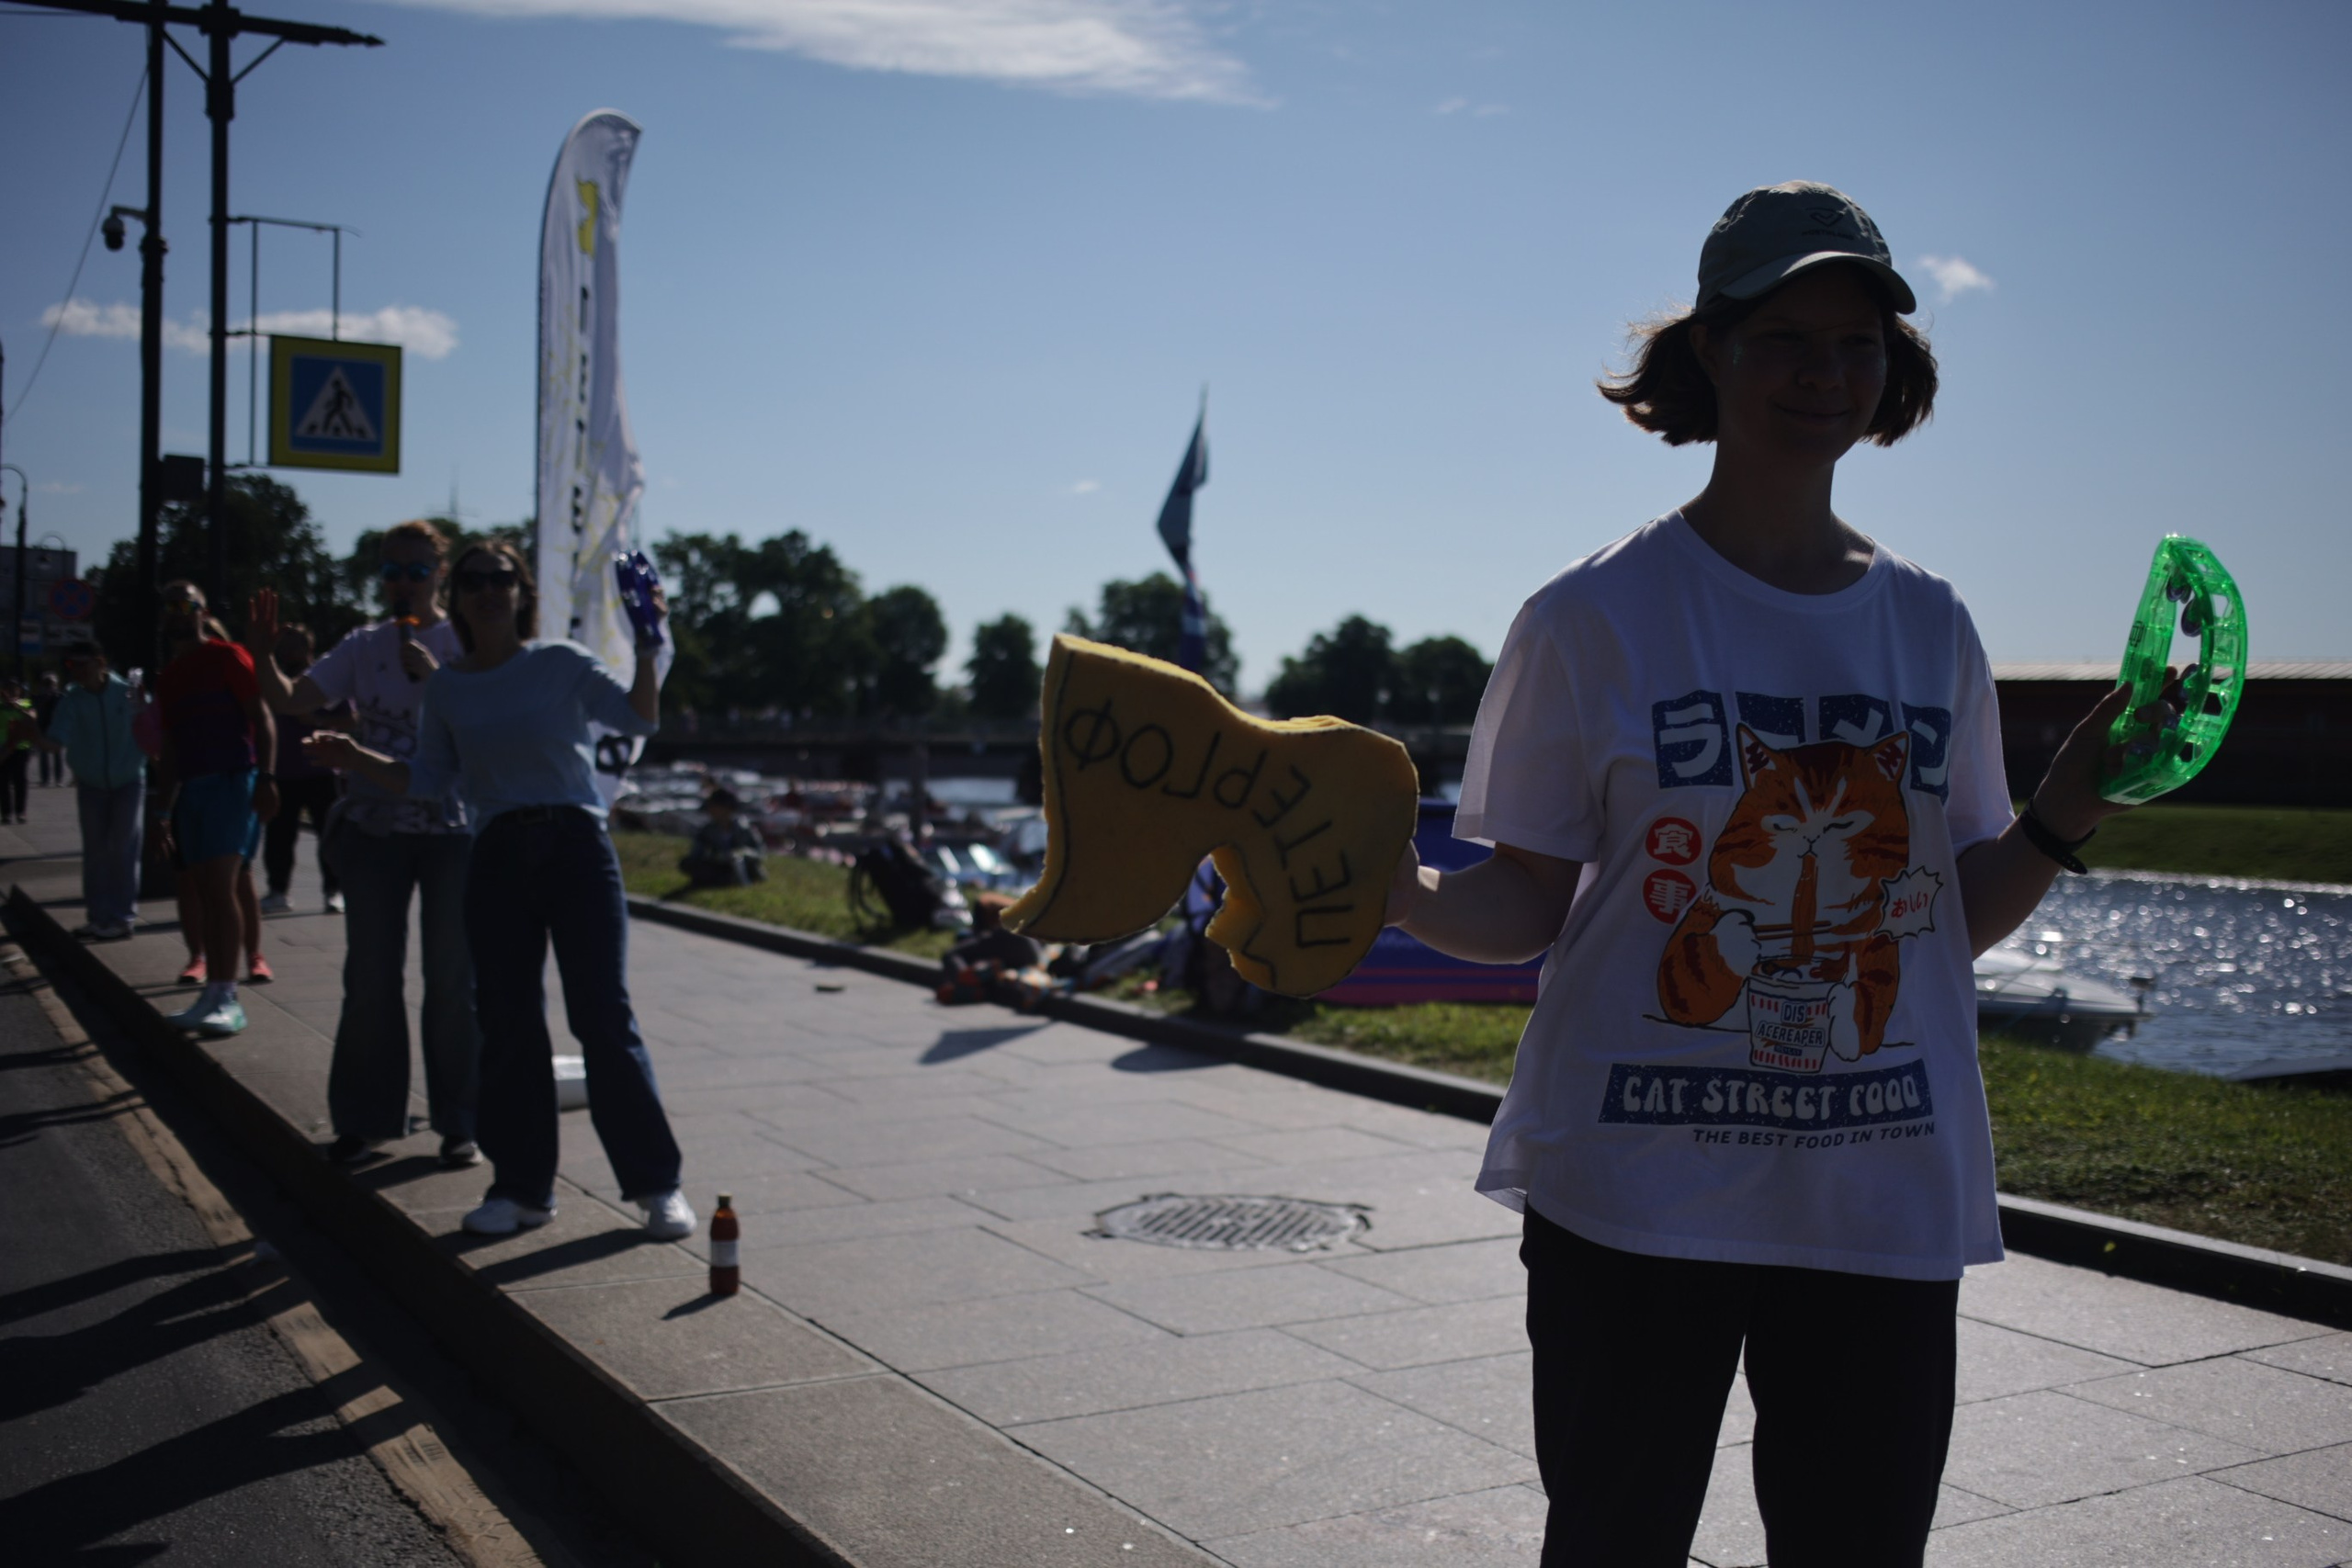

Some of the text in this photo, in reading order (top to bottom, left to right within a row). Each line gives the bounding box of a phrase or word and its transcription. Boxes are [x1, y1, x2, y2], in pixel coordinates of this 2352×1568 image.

[1063, 700, 1353, 948] ПЕТЕРГОФ
[1783, 1004, 1805, 1023] DIS
[1623, 1074, 1922, 1121] CAT STREET FOOD
[1693, 1122, 1935, 1149] THE BEST FOOD IN TOWN
